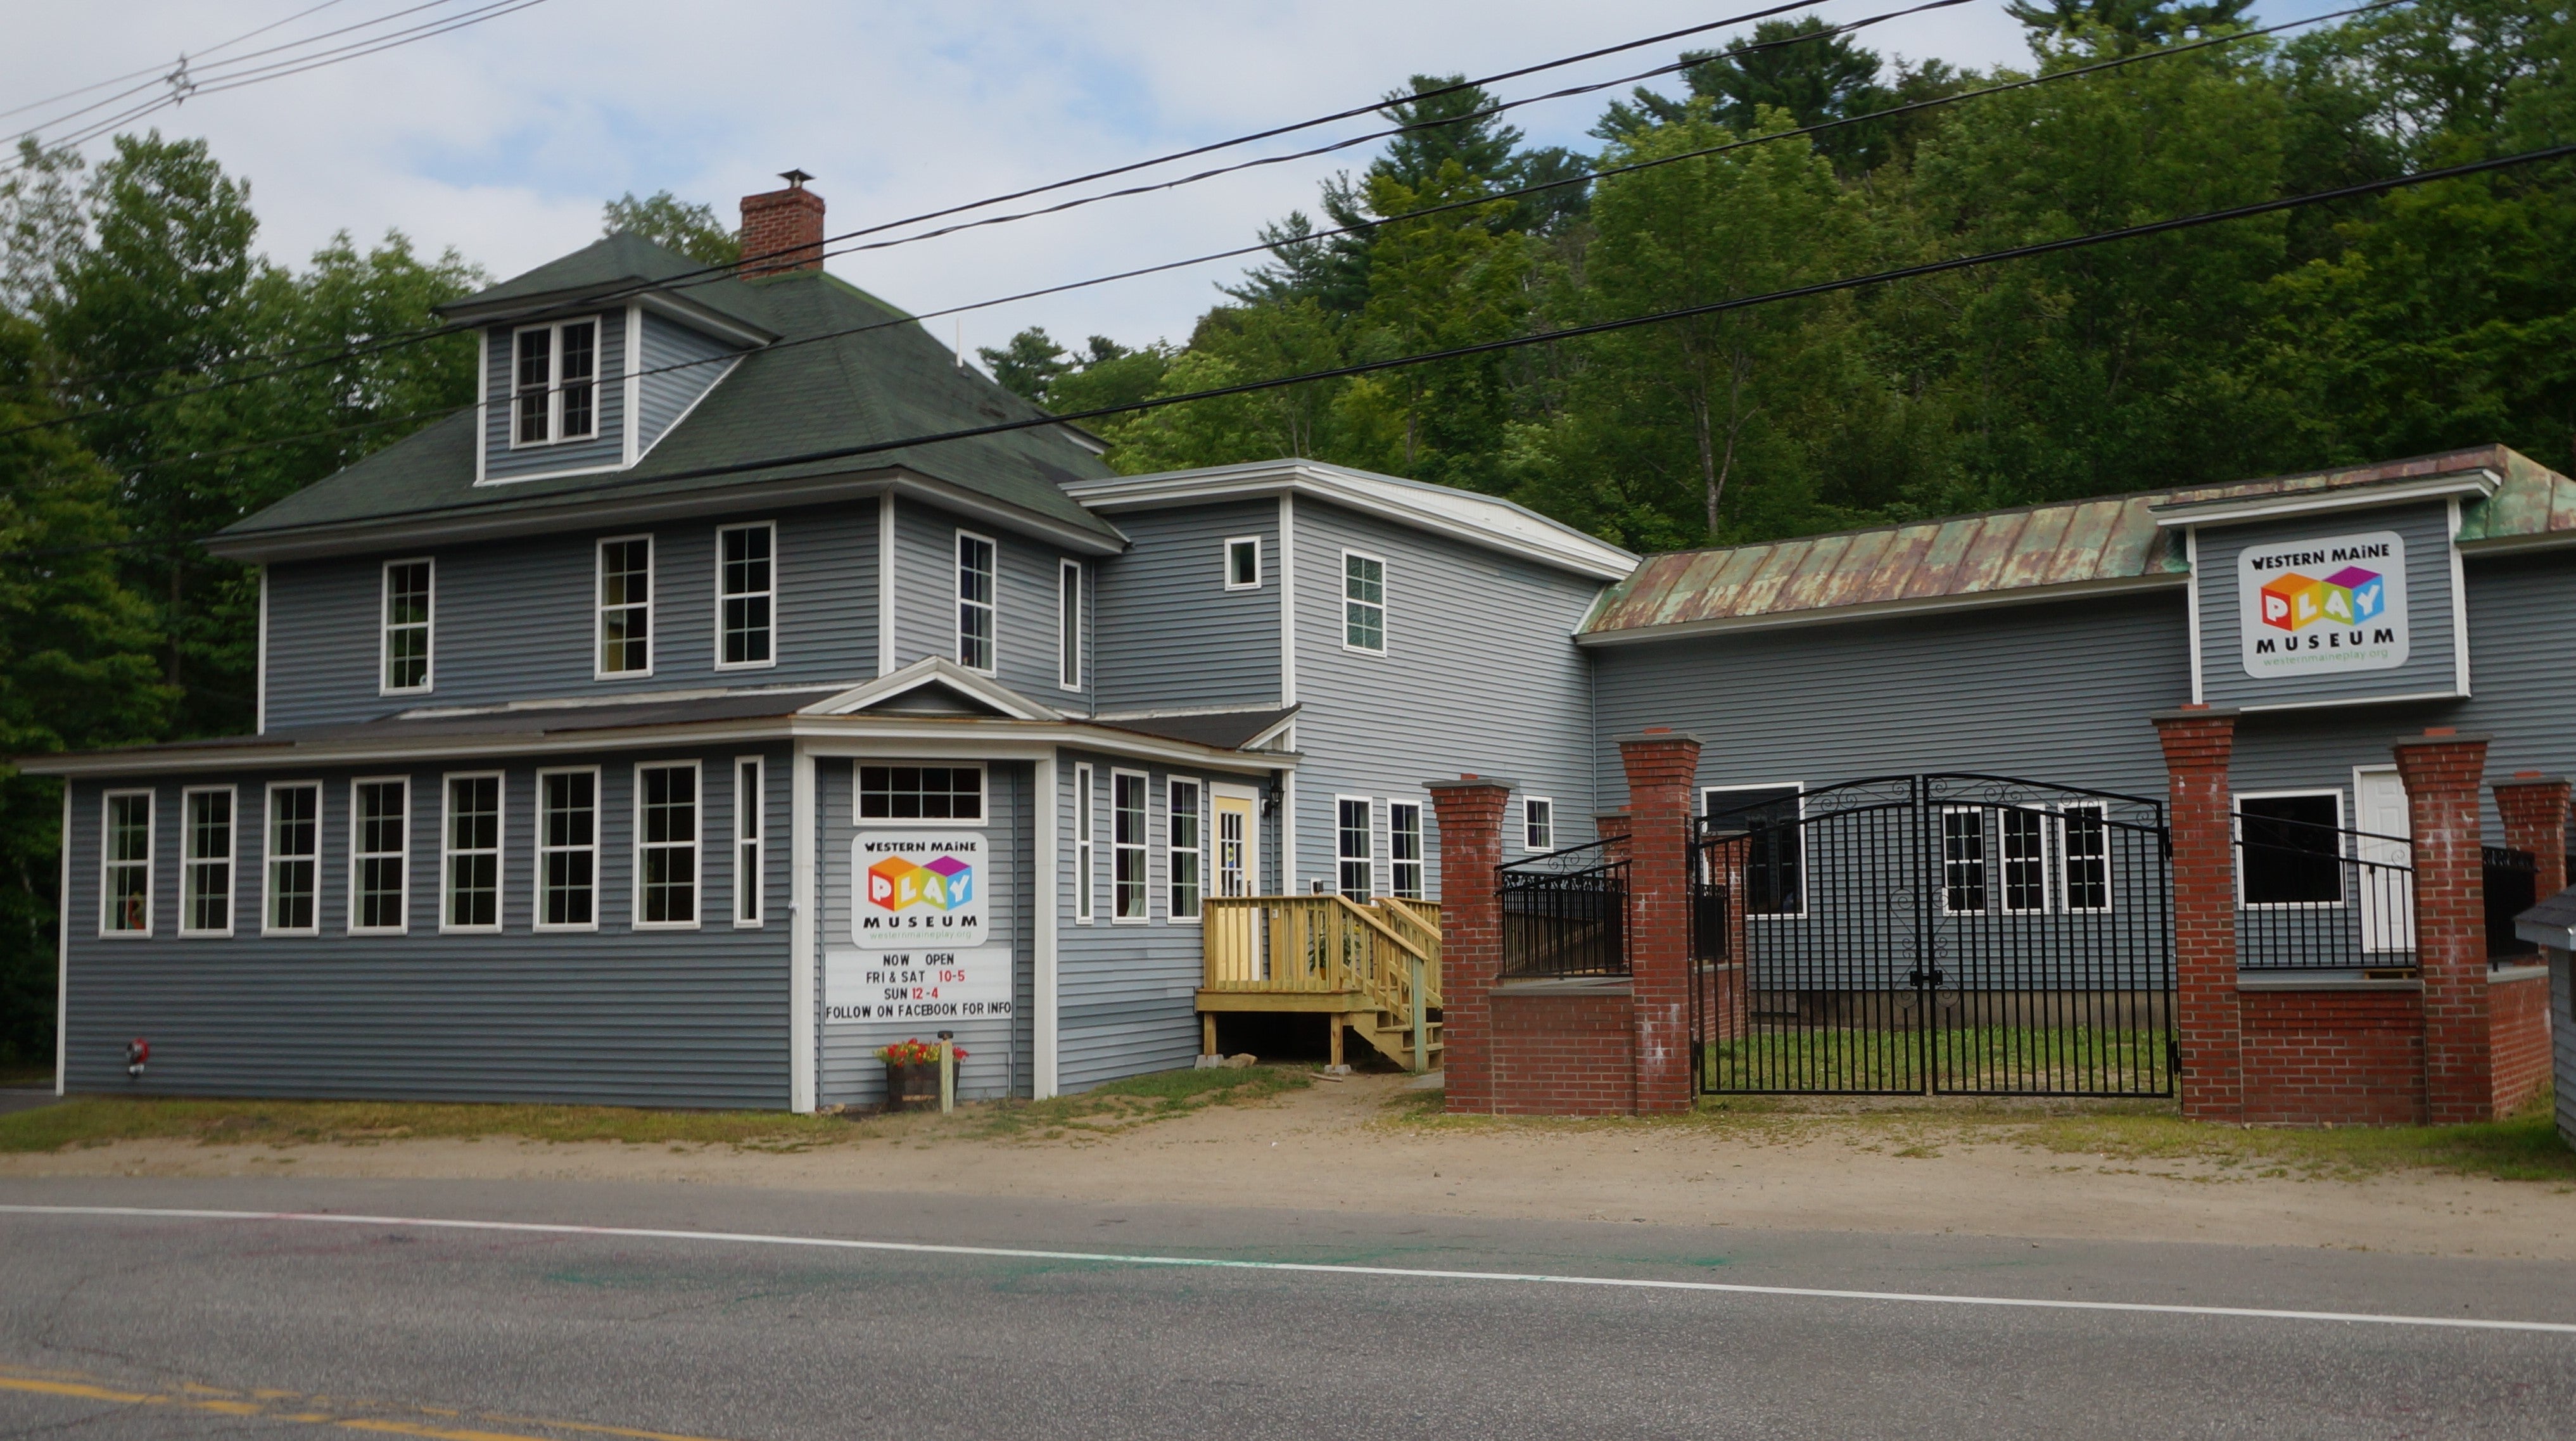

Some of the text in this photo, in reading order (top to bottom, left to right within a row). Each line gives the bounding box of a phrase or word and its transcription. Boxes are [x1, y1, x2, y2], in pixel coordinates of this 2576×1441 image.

[2251, 550, 2325, 570] WESTERN
[2265, 585, 2380, 622] PLAY
[2256, 628, 2394, 654] MUSEUM
[2263, 649, 2389, 666] westernmaineplay.org
[865, 842, 925, 852] WESTERN
[872, 875, 970, 903] PLAY
[863, 916, 977, 929] MUSEUM
[870, 930, 972, 940] westernmaineplay.org
[883, 953, 955, 967] NOW OPEN
[866, 970, 965, 984] FRI & SAT 10-5
[884, 988, 908, 1000] SUN
[826, 1001, 1012, 1019] FOLLOW ON FACEBOOK FOR INFO
